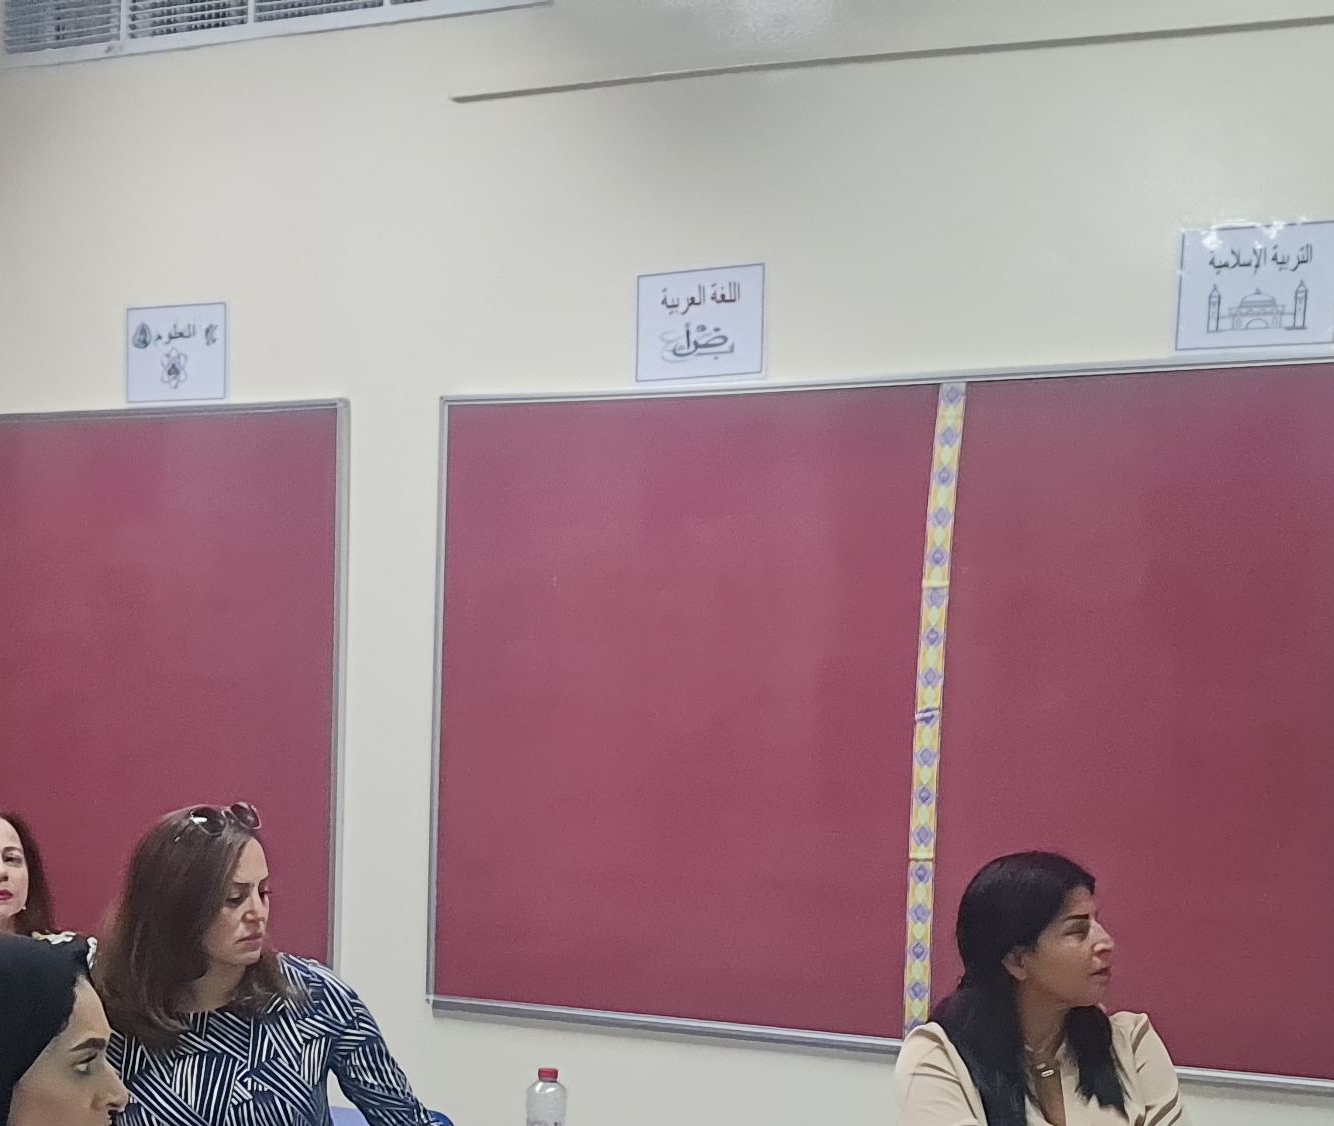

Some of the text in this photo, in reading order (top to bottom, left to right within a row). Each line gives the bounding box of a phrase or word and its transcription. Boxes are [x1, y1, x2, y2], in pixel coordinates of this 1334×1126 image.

[1208, 243, 1313, 275] التربية الإسلامية
[661, 281, 741, 316] اللغة العربية
